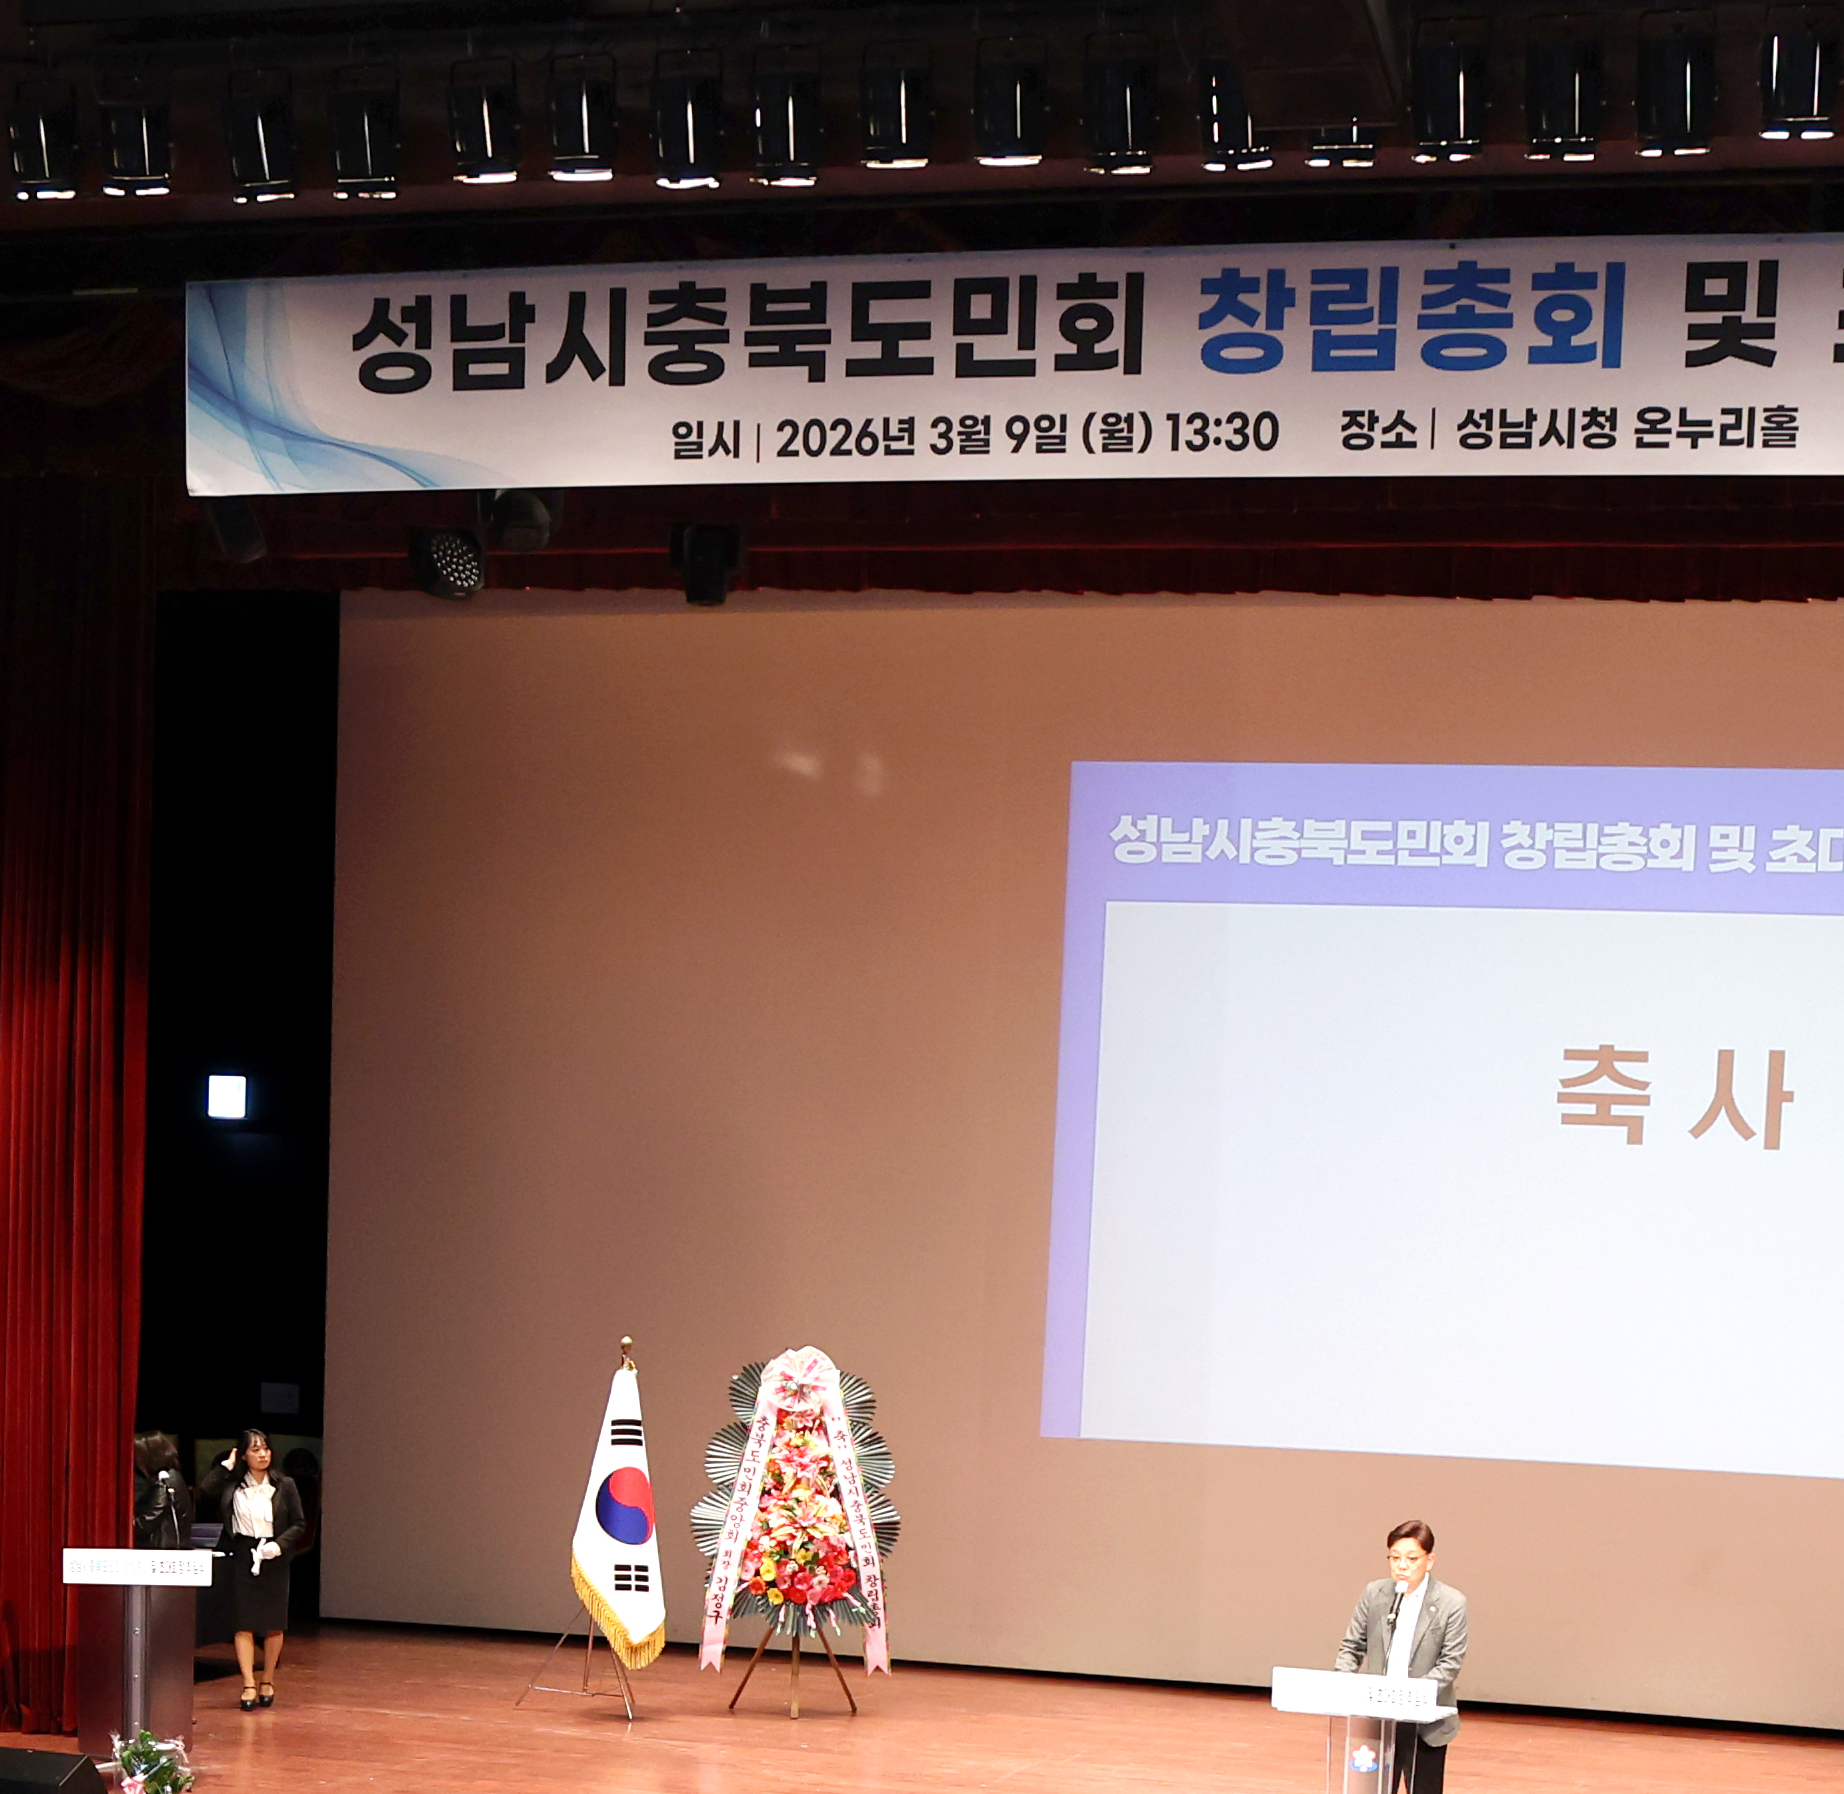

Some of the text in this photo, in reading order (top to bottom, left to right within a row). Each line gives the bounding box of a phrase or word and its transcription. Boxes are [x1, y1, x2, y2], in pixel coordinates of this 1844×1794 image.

[352, 272, 1147, 396] 성남시충북도민회
[1197, 259, 1628, 375] 창립총회
[1683, 256, 1780, 369] 및
[672, 405, 1799, 459] 일시 2026년 3월 9일 (월) 13:30 장소 성남시청 온누리홀
[1108, 814, 1490, 870] 성남시충북도민회
[1502, 821, 1697, 874] 창립총회
[1707, 826, 1758, 876] 및
[839, 1457, 876, 1568] 성남시충북도민회
